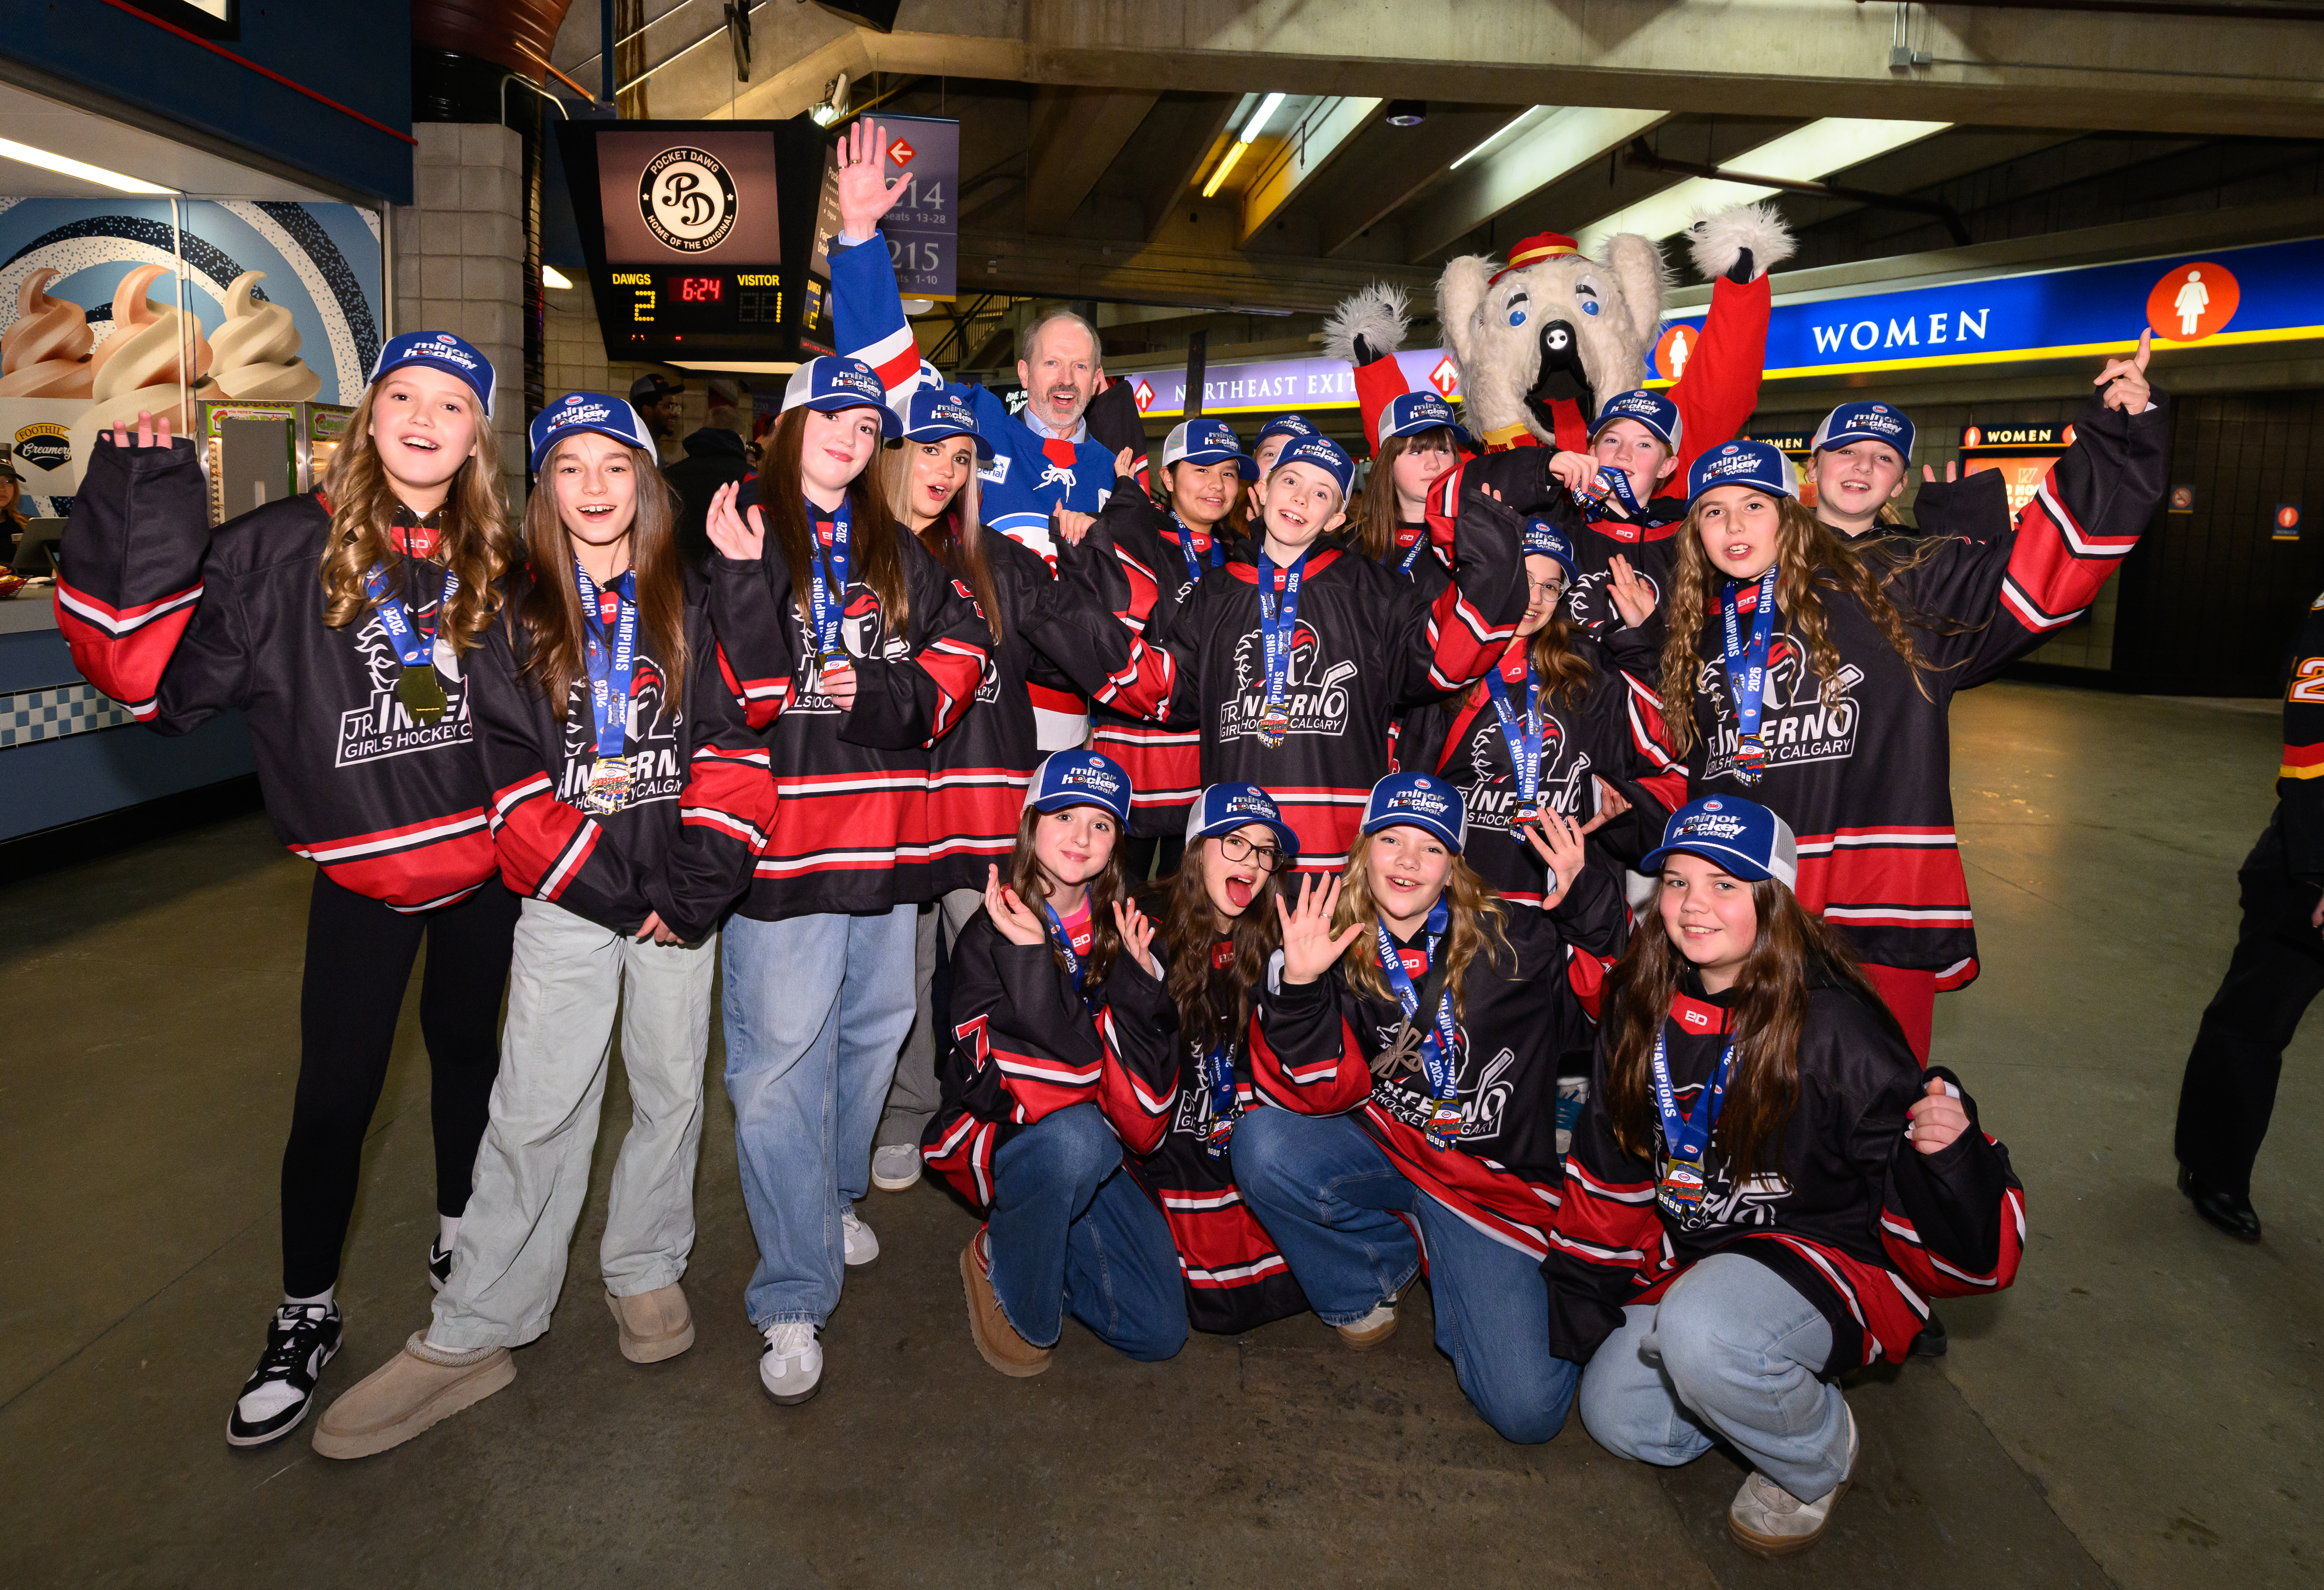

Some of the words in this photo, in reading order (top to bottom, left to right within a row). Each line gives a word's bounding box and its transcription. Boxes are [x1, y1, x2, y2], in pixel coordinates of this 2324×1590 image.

[650, 151, 687, 174] POCKET
[690, 151, 719, 172] DAWG
[883, 212, 910, 221] Seats
[916, 213, 946, 223] 13-28
[648, 215, 669, 240] HOME
[670, 237, 682, 246] OF
[702, 214, 733, 247] ORIGINAL
[886, 240, 938, 271] 215
[612, 274, 651, 285] DAWGS
[737, 275, 779, 286] VISITOR
[807, 279, 821, 295] DAWGS
[915, 275, 937, 284] 1-10
[683, 279, 720, 300] 6:24
[634, 291, 655, 321] 2
[776, 292, 781, 323] 1
[809, 299, 820, 330] 2
[1812, 309, 1990, 354] WOMEN
[414, 342, 473, 359] minor
[403, 349, 478, 370] hockey
[839, 371, 879, 386] minor
[831, 377, 882, 397] hockey
[1175, 376, 1297, 401] NRTHEAST
[1308, 372, 1356, 394] EXIT
[1414, 402, 1445, 411] minor
[1610, 402, 1661, 413] hockey
[1618, 397, 1658, 406] minor
[551, 404, 603, 424] minor
[937, 404, 971, 416] minor
[1410, 408, 1448, 419] hockey
[1629, 408, 1653, 416] week
[547, 409, 611, 433] hockey
[931, 410, 974, 426] hockey
[1276, 420, 1308, 429] minor
[1854, 413, 1900, 424] minor
[1846, 420, 1902, 433] hockey
[1871, 426, 1896, 436] week
[1205, 437, 1238, 449] hockey
[1209, 431, 1237, 441] minor
[1988, 430, 2051, 442] WOMEN
[23, 443, 71, 460] Creamery
[1293, 448, 1342, 466] hockey
[1301, 444, 1340, 458] minor
[1708, 453, 1756, 472] minor
[1702, 459, 1762, 484] hockey
[1726, 468, 1756, 476] week
[835, 521, 848, 544] 2026
[1616, 530, 1633, 538] BD
[1187, 542, 1197, 562] minor
[1287, 572, 1299, 593] 2026
[1261, 594, 1269, 618] minor
[1738, 595, 1757, 608] BD
[383, 607, 407, 636] 2026
[615, 600, 636, 671] CHAMPIONS
[1725, 603, 1740, 657] CHAMPIONS
[1747, 666, 1762, 692] 2026
[594, 680, 608, 708] 2026
[1732, 686, 1741, 704] week
[1493, 700, 1508, 724] minor
[1503, 697, 1512, 712] week
[1222, 705, 1241, 724] JR.
[345, 713, 377, 740] JR.
[1290, 718, 1341, 731] CALGARY
[345, 736, 393, 758] GIRLS
[396, 724, 457, 747] HOCKEY
[1734, 752, 1764, 760] minor
[1780, 739, 1851, 760] CALGARY
[592, 775, 628, 785] minor
[1070, 767, 1117, 781] minor
[1734, 768, 1751, 782] 2026
[1061, 774, 1120, 792] hockey
[1088, 784, 1115, 797] week
[1233, 795, 1273, 808] minor
[1396, 789, 1445, 802] minor
[1226, 803, 1277, 818] hockey
[1387, 798, 1449, 812] hockey
[1413, 806, 1442, 817] week
[1682, 812, 1741, 826] minor
[1510, 830, 1525, 840] 2026
[1672, 820, 1747, 839] hockey
[1697, 831, 1735, 840] week
[1072, 933, 1091, 948] BD
[1685, 1010, 1708, 1026] BD
[1429, 1060, 1443, 1087] 2026
[1376, 1093, 1430, 1128] HOCKEY
[1429, 1117, 1461, 1126] minor
[1426, 1134, 1444, 1146] 2026
[1685, 1145, 1697, 1153] Esso
[1662, 1179, 1703, 1189] minor
[1659, 1194, 1680, 1211] 2026
